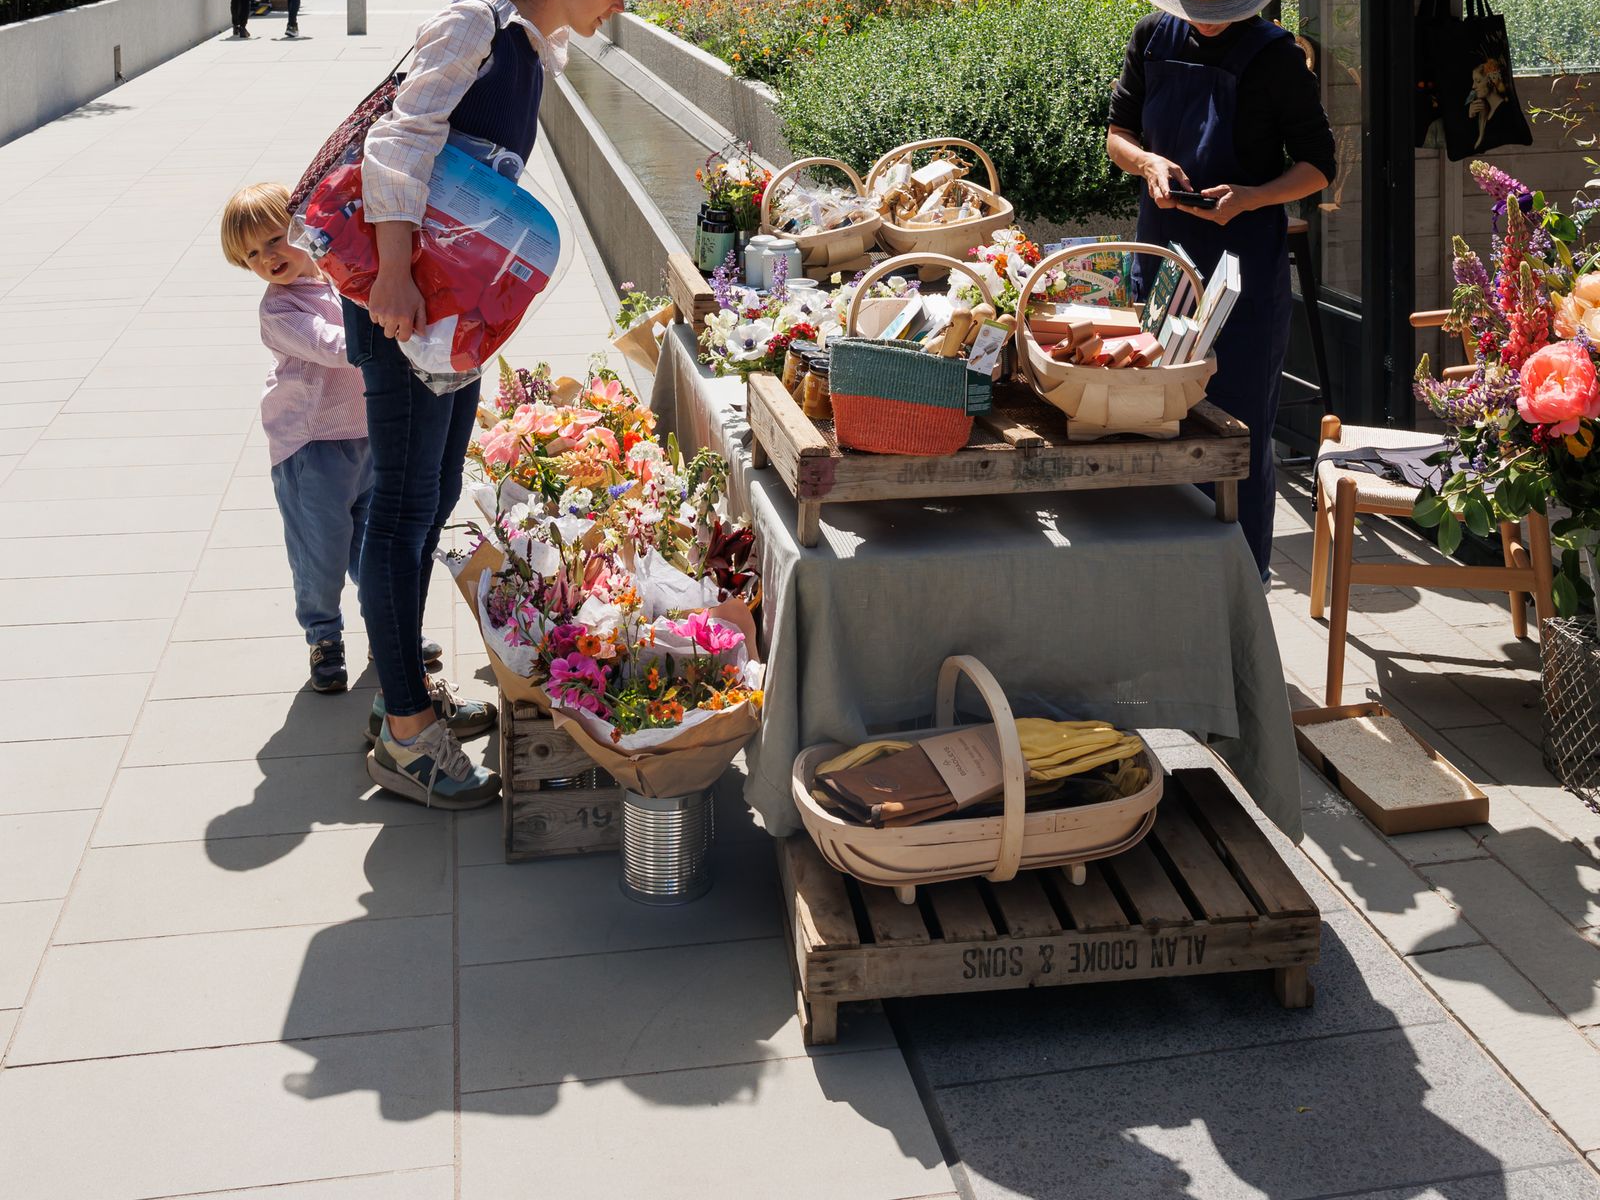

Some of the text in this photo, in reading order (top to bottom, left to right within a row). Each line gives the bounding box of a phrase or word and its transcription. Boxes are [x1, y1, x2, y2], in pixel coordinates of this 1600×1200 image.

[576, 806, 613, 829] 19
[962, 934, 1208, 980] ALAN COOKE & SONS
